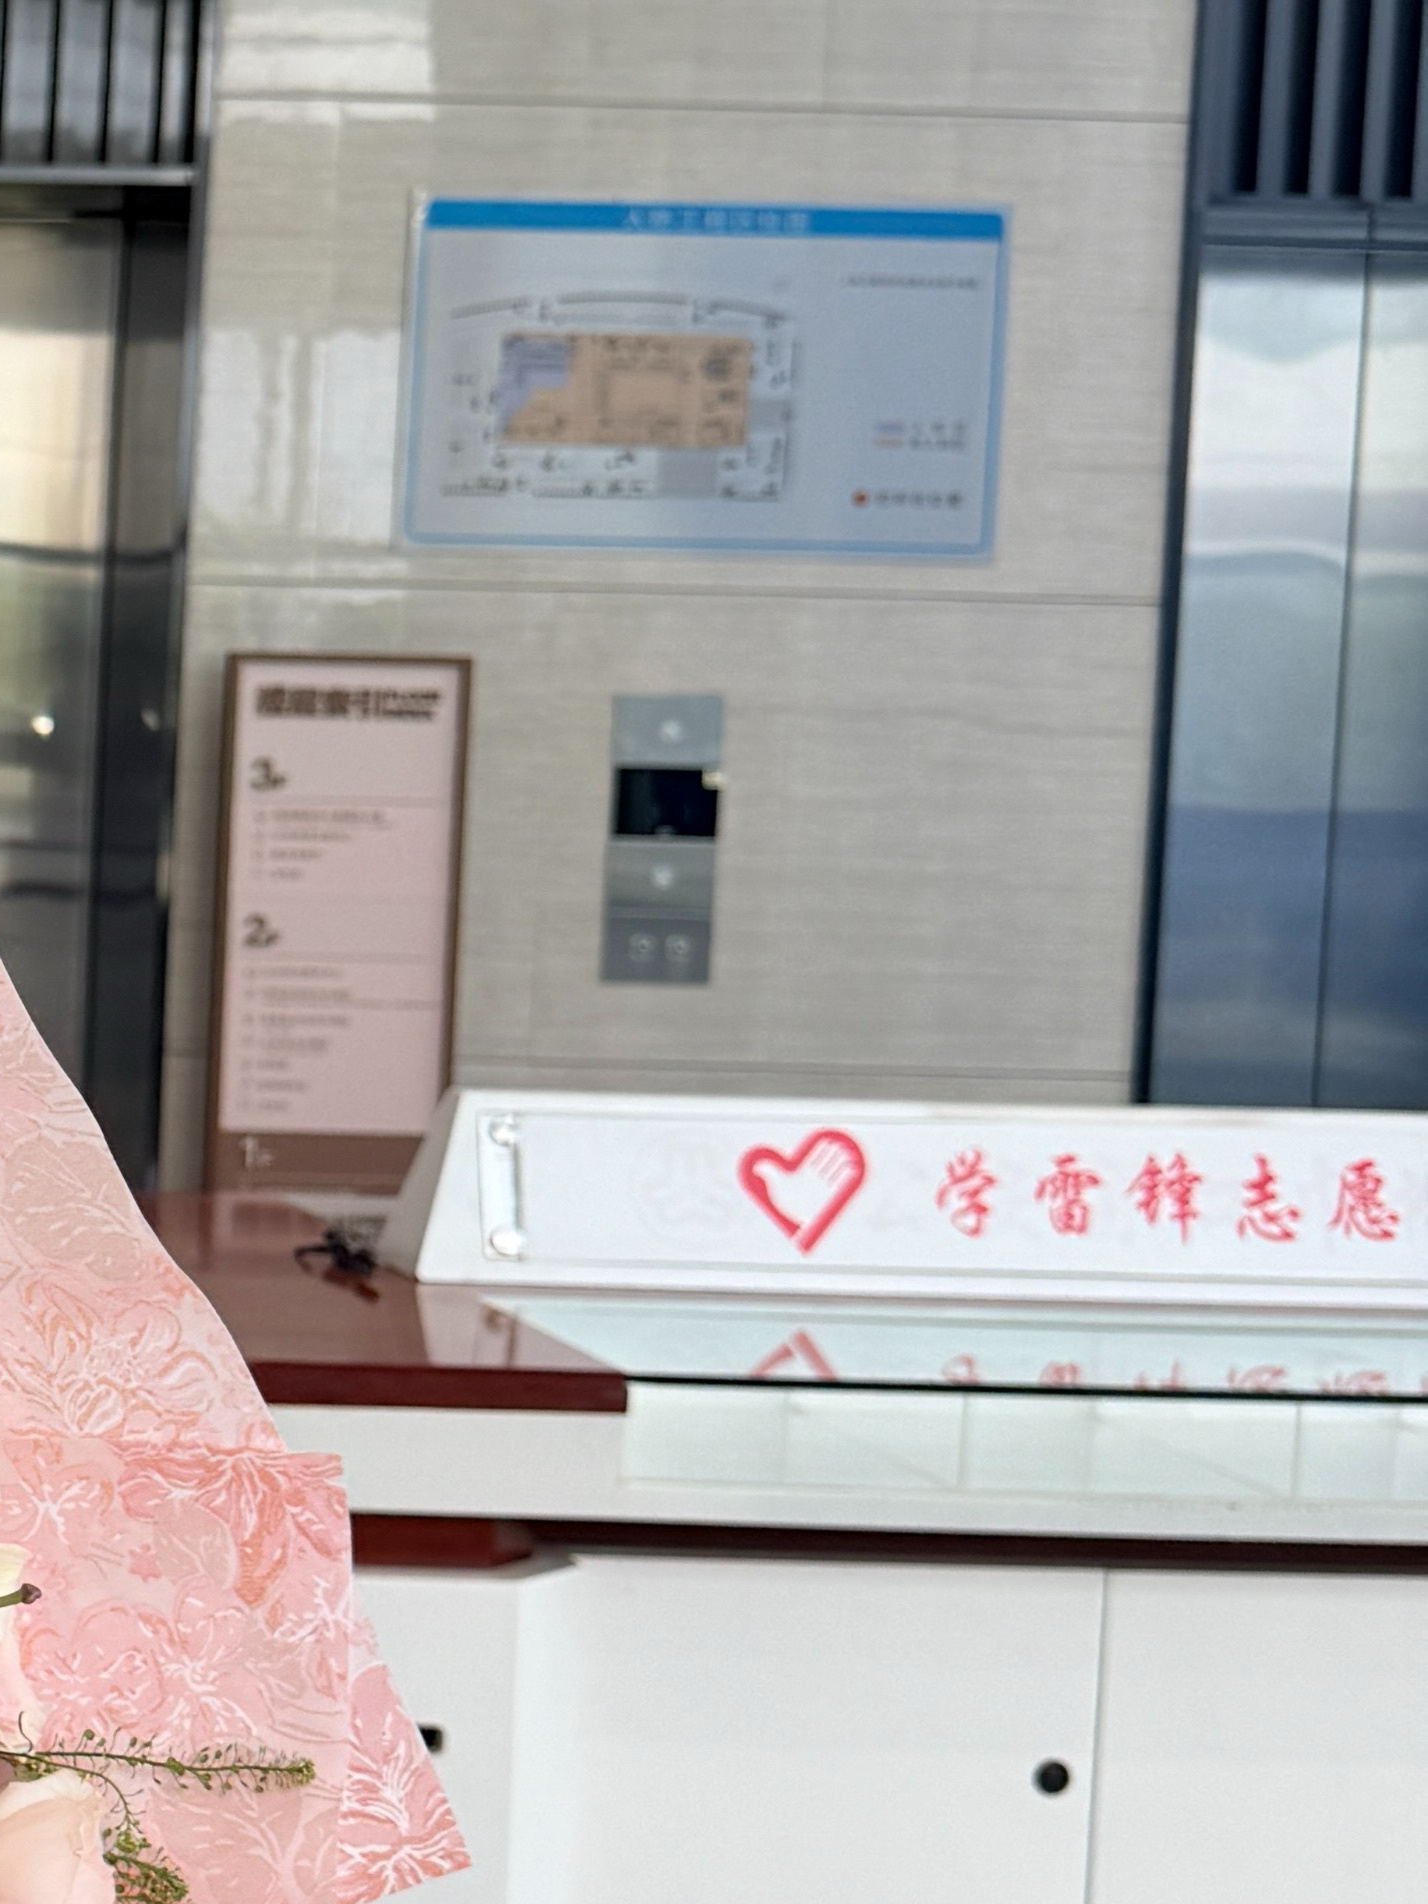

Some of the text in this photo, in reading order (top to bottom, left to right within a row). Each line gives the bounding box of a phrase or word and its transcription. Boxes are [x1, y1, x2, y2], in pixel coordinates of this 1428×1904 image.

[935, 1147, 1400, 1244] 学雷锋志愿
